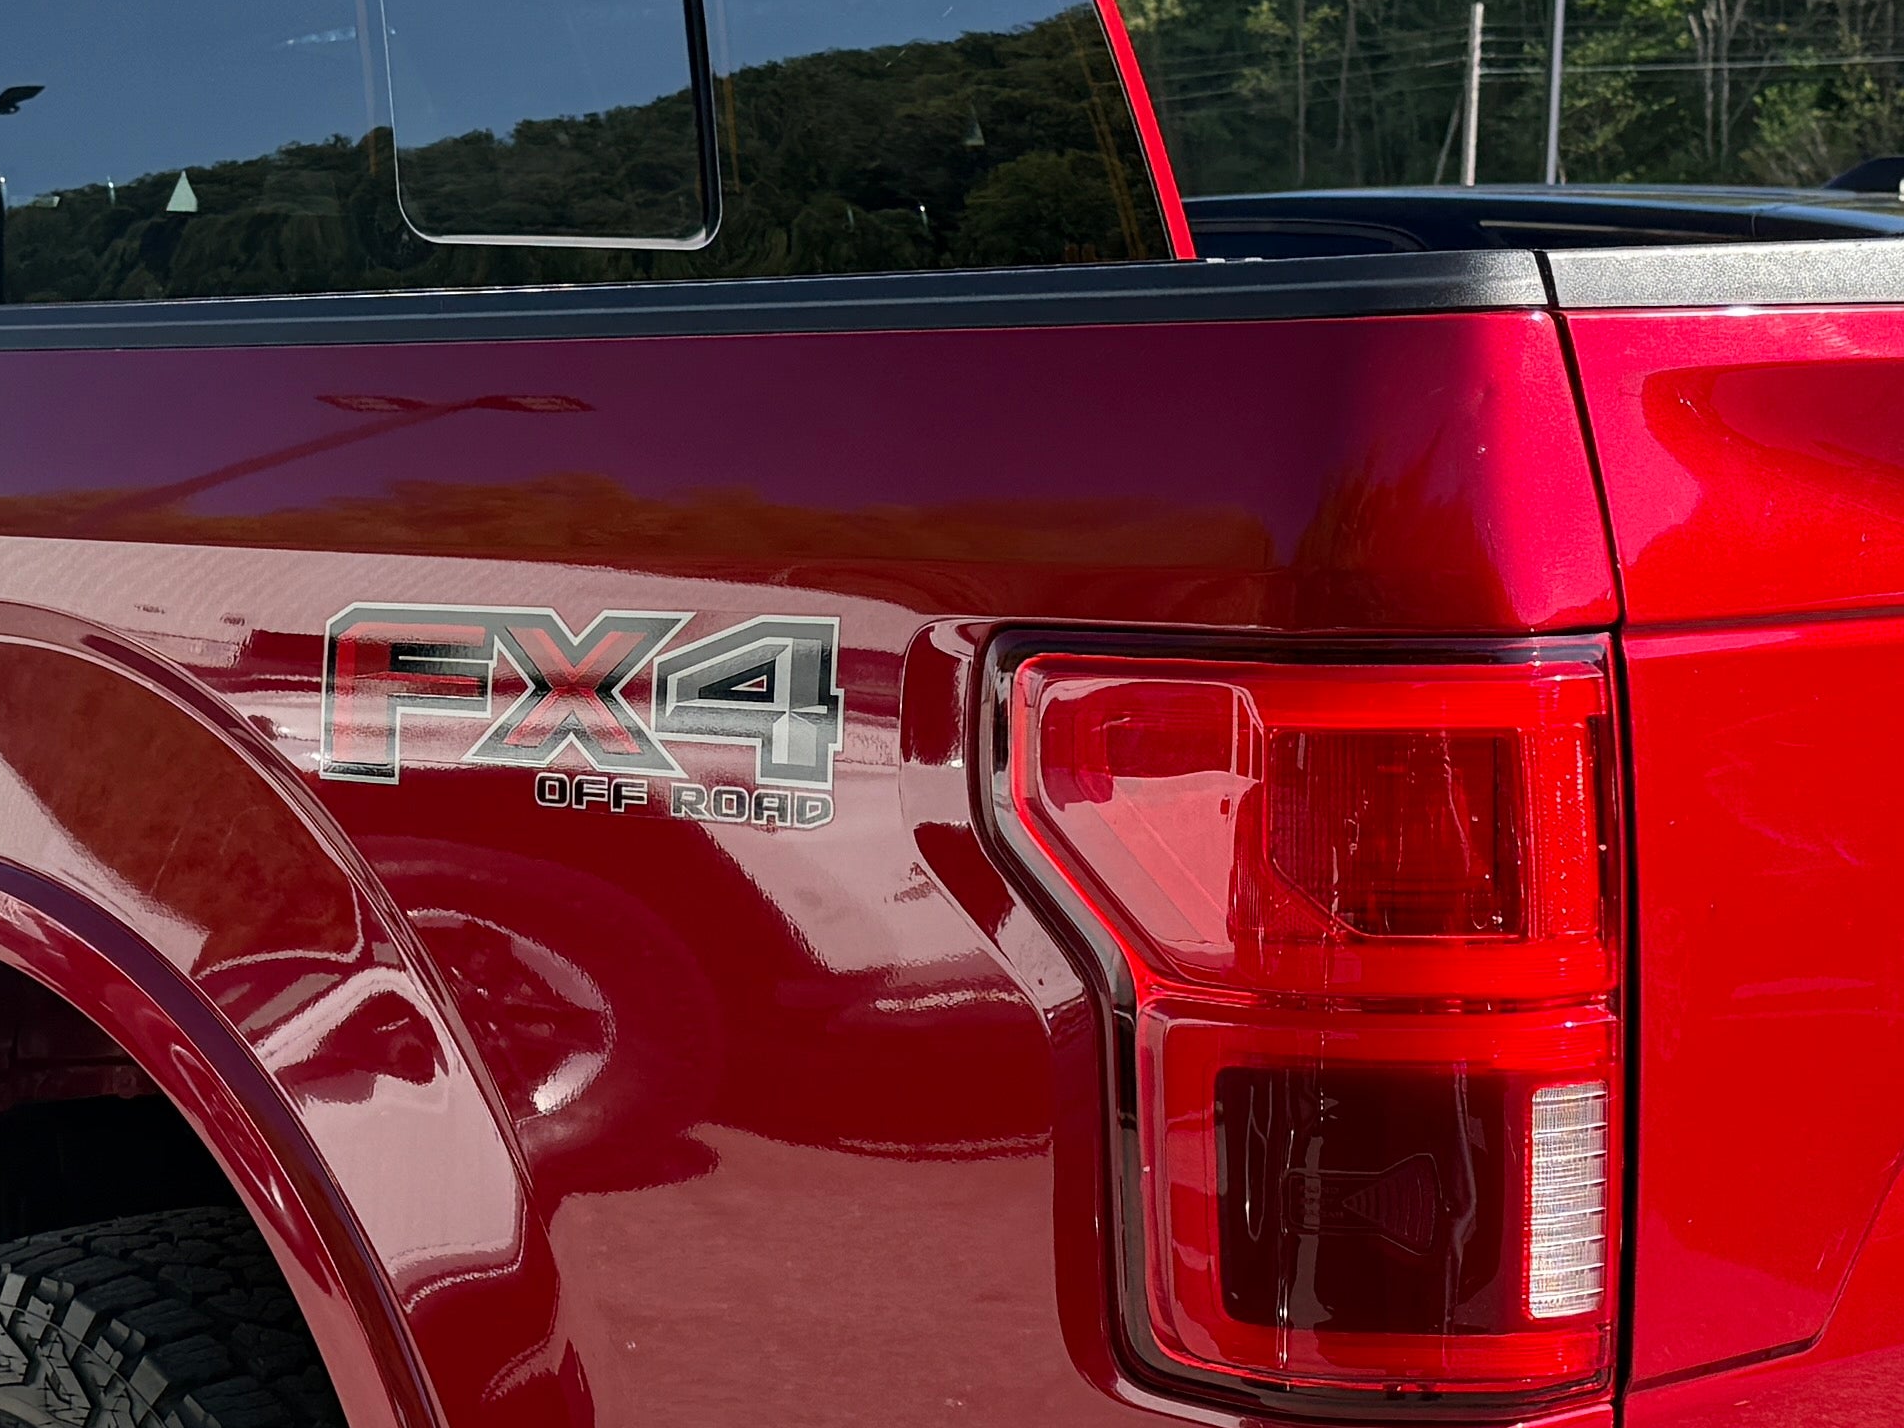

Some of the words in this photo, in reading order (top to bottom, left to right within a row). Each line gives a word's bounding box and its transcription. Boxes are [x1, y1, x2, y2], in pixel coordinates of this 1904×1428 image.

[319, 601, 845, 789] FX4
[535, 772, 648, 812] OFF
[671, 782, 835, 829] ROAD
